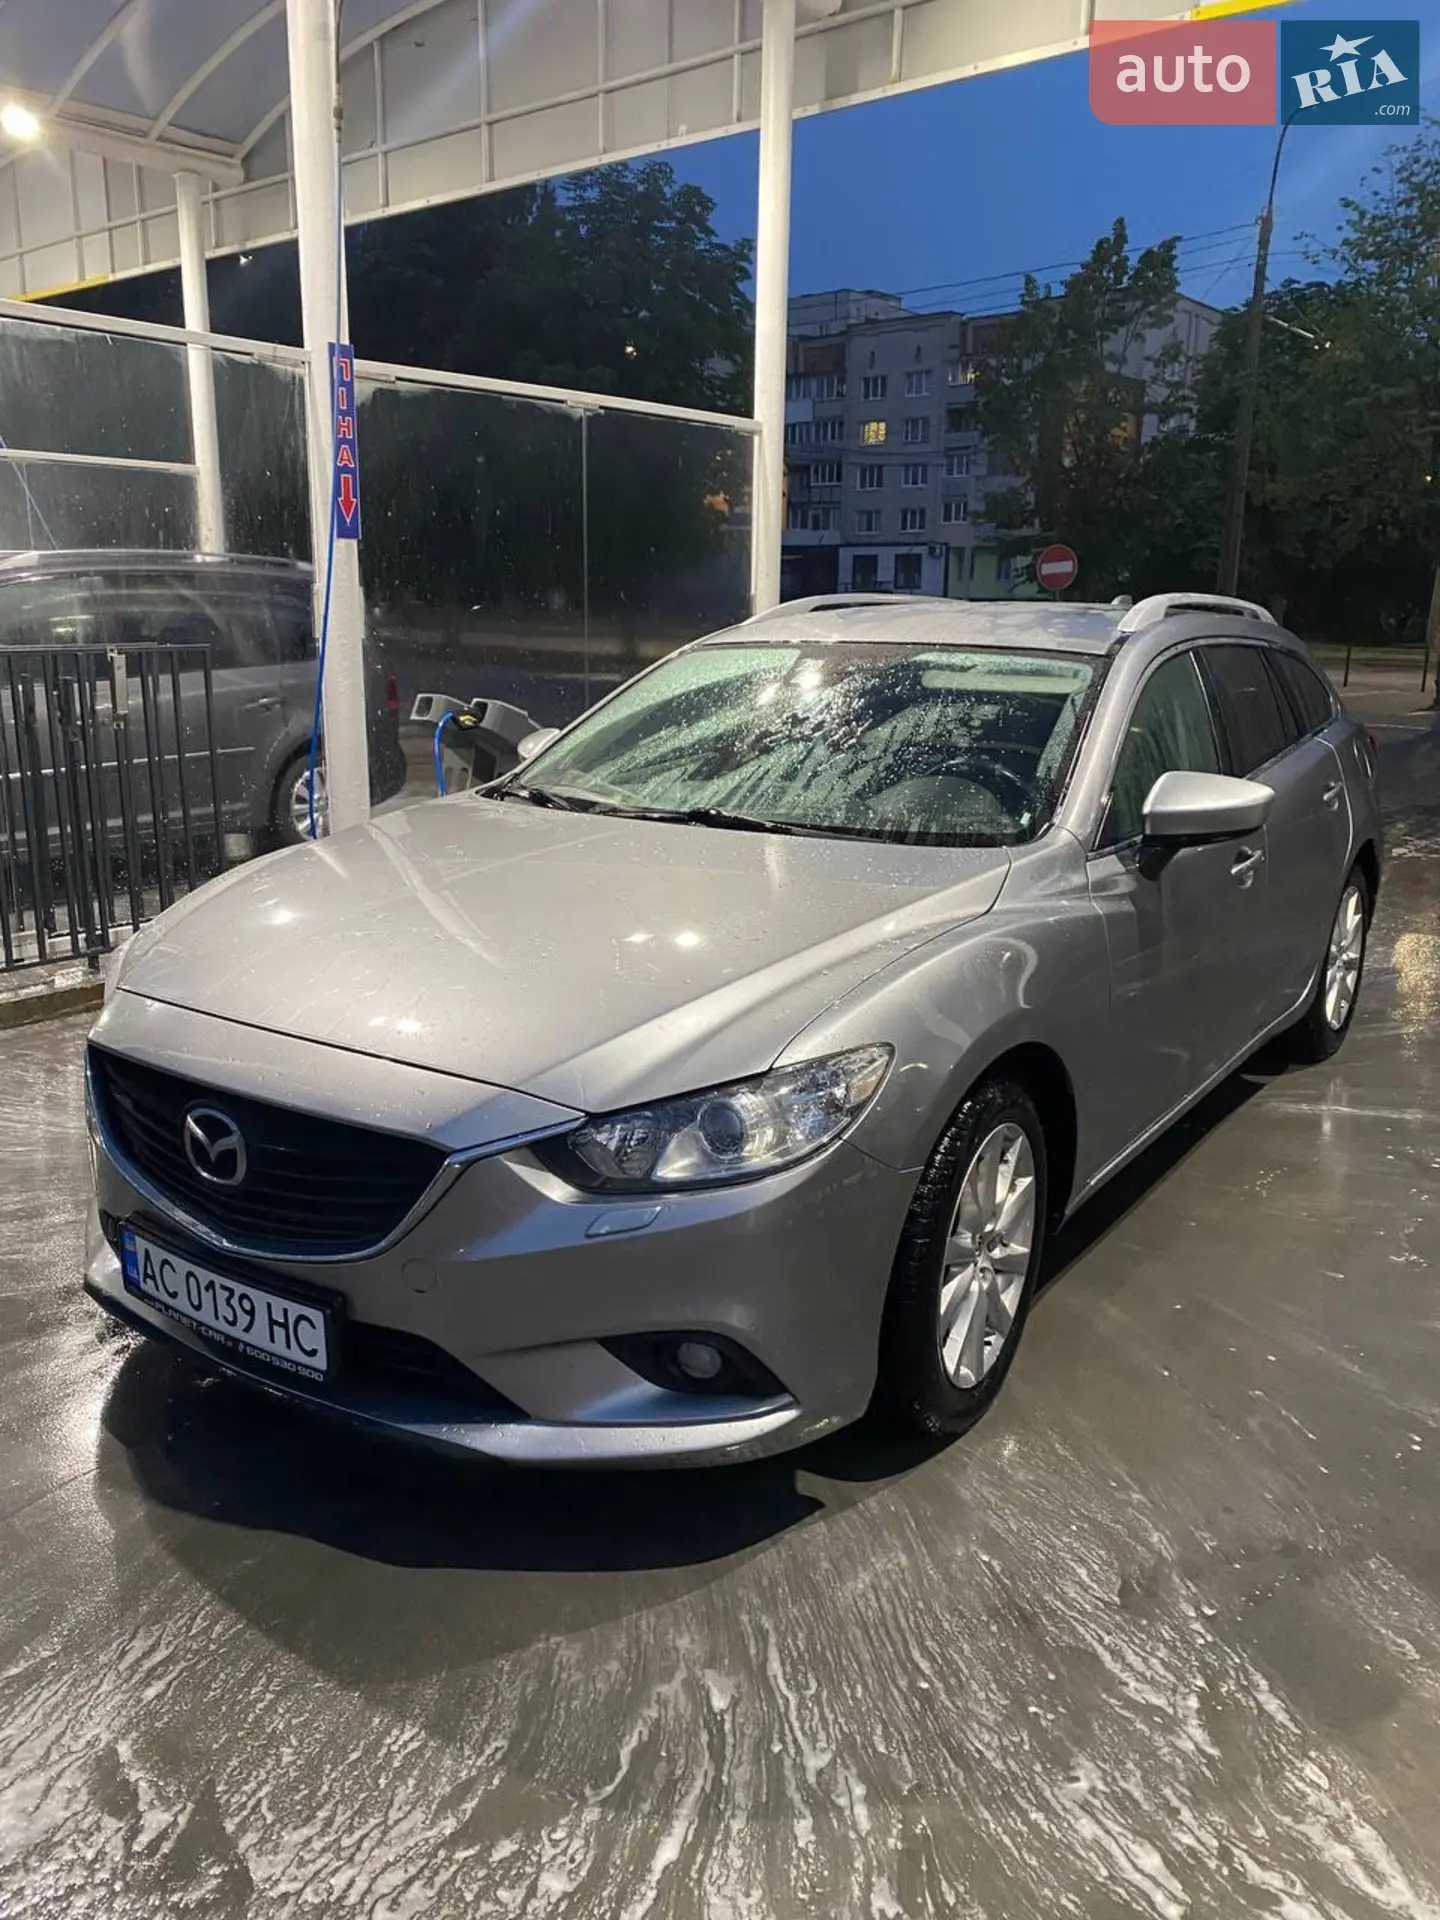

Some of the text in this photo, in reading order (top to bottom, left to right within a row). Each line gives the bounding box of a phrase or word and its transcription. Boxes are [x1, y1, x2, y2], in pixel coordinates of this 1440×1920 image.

[142, 1248, 319, 1358] AC 0139 HC
